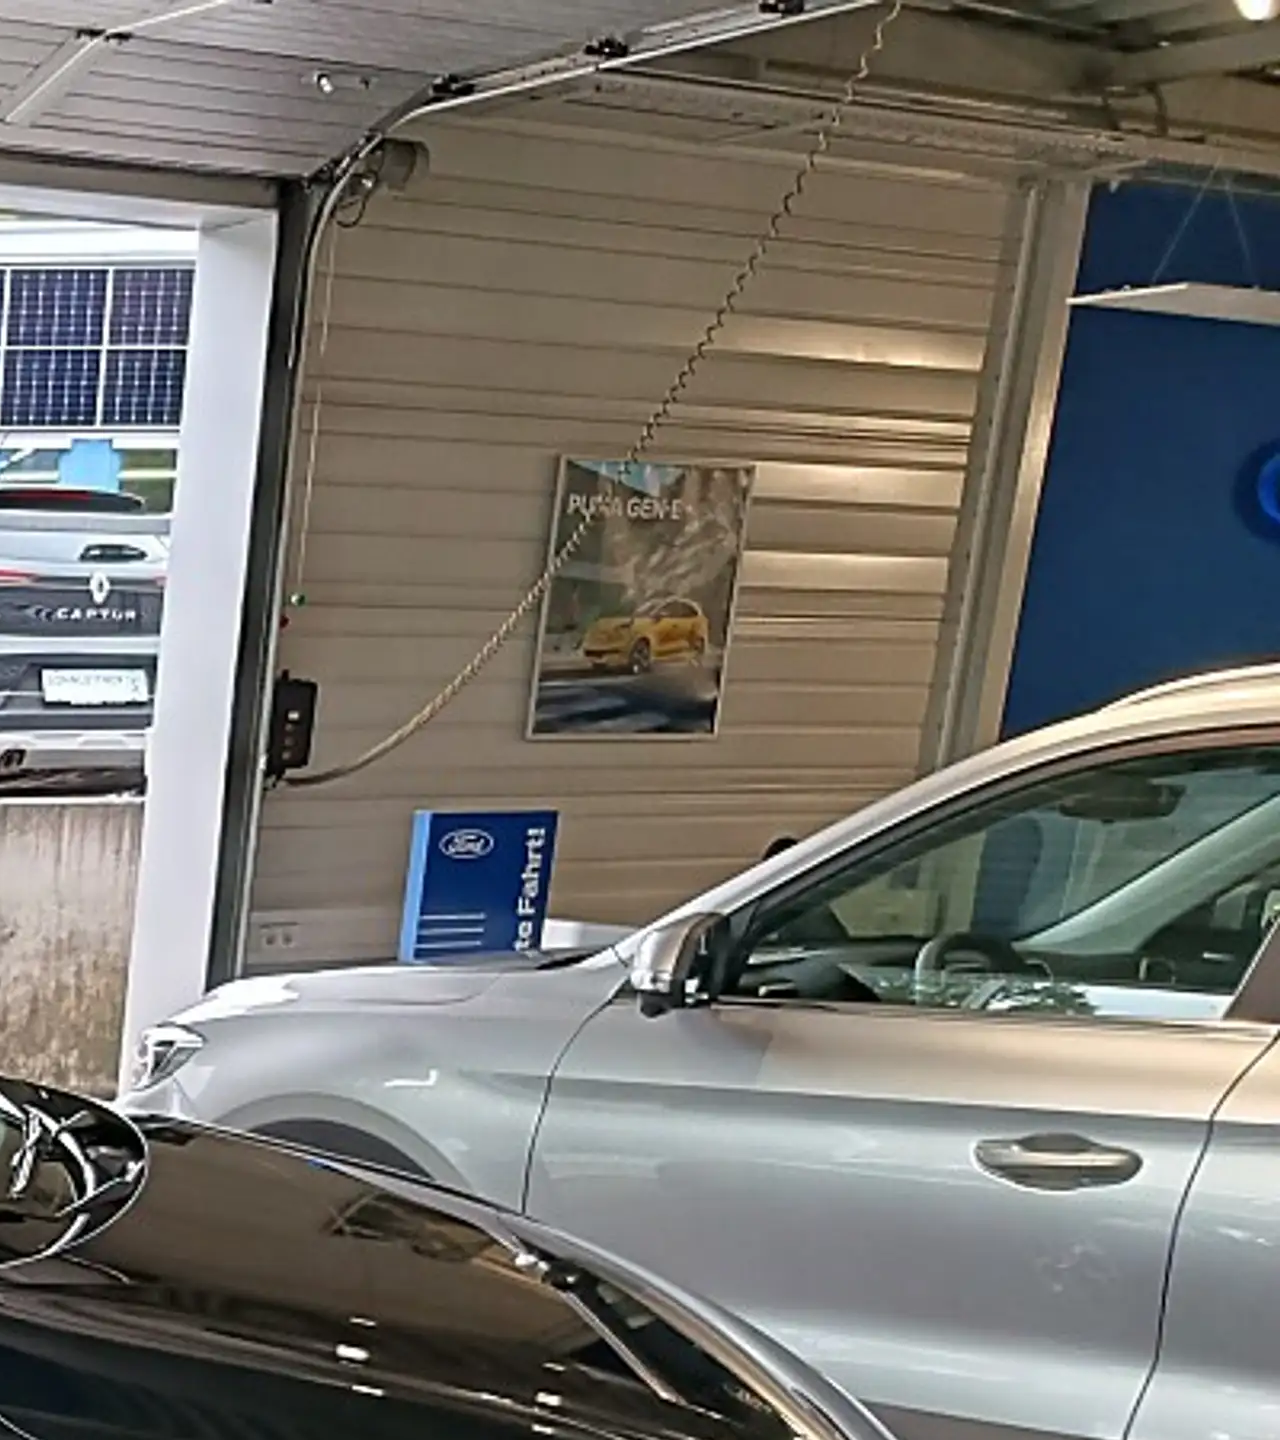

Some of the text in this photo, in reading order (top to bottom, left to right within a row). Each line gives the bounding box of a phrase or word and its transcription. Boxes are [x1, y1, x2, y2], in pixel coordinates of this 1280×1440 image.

[57, 607, 136, 620] CAPTUR
[514, 827, 546, 953] te Fahrt!
